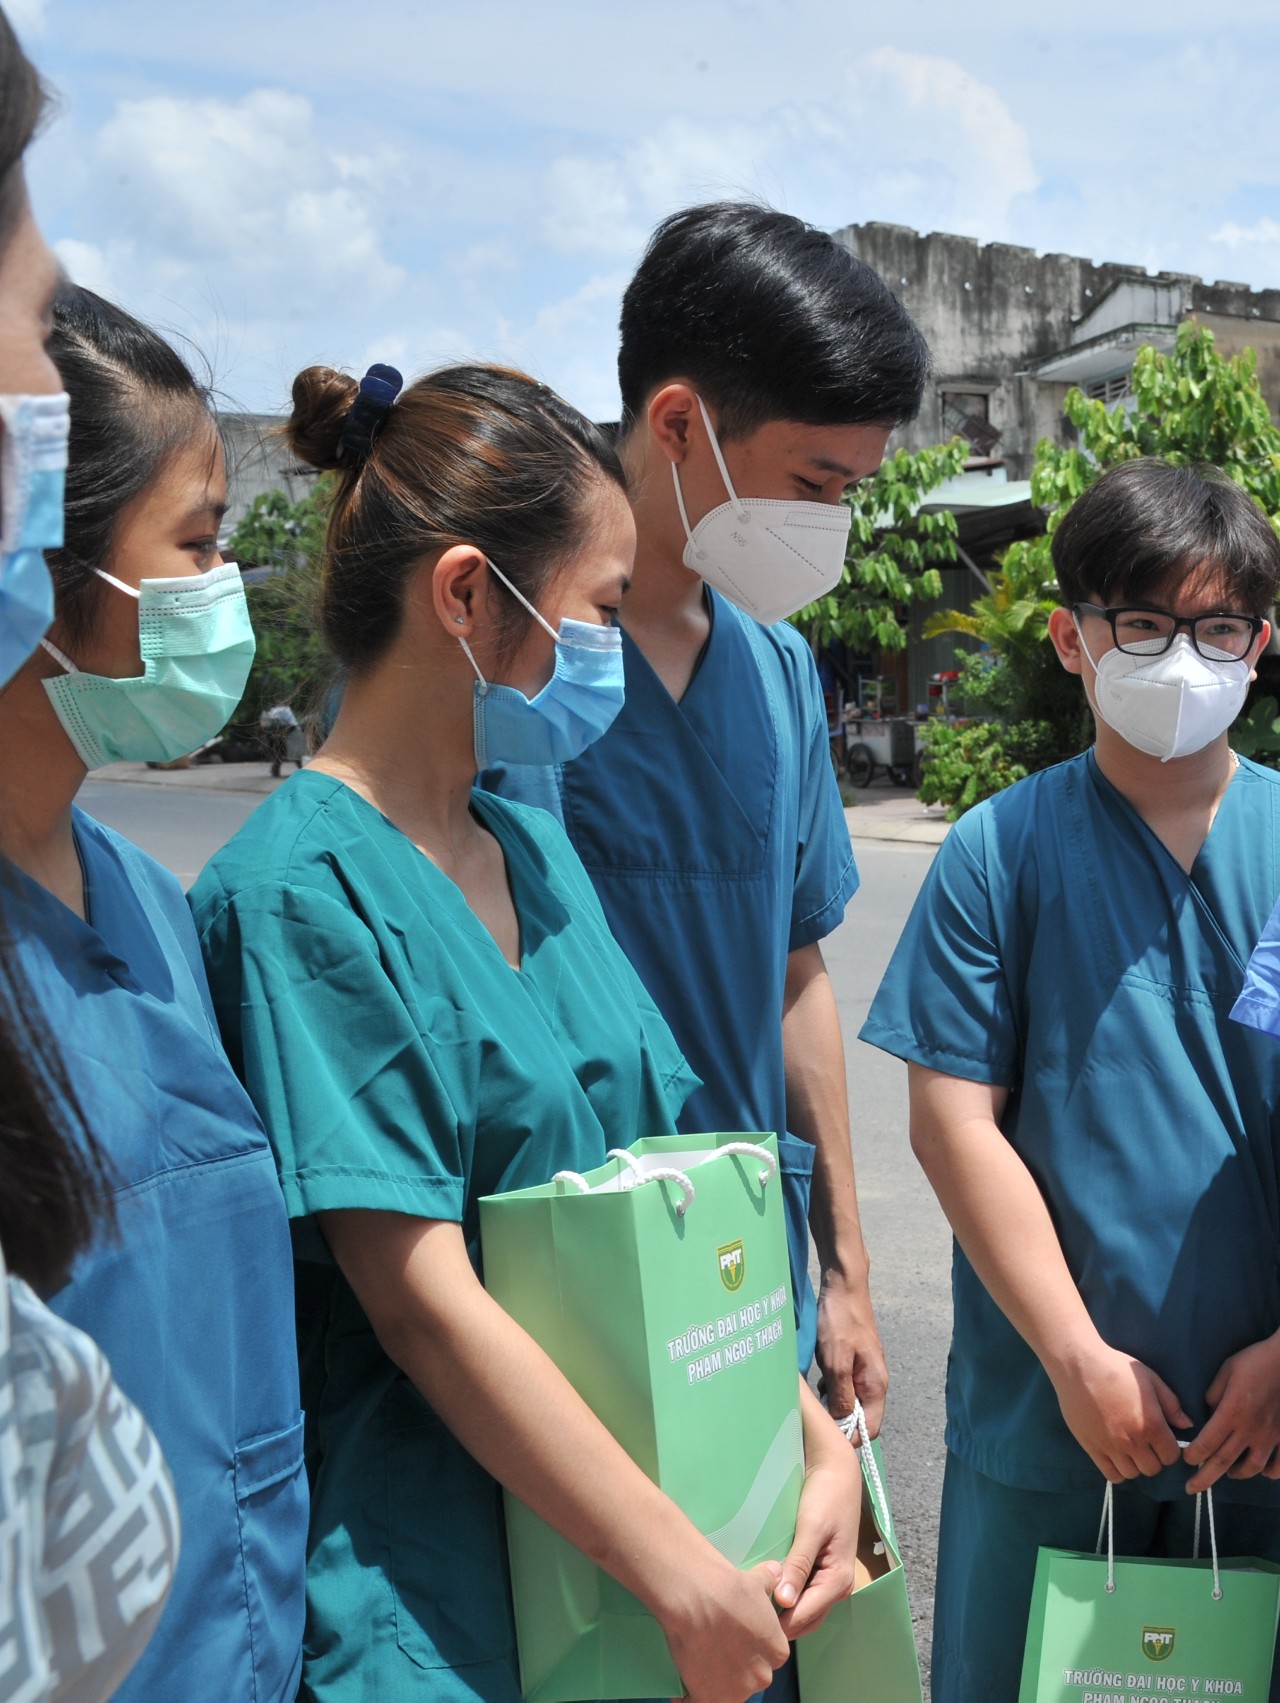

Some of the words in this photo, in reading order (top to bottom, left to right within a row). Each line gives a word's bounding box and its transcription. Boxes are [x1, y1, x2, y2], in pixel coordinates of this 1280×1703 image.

[667, 1323, 715, 1362] TRƯỜNG
[717, 1312, 737, 1340] ĐẠI
[739, 1301, 761, 1329] HỌC
[762, 1296, 770, 1317] Y
[770, 1285, 787, 1314] KHOA
[687, 1350, 721, 1384] PHẠM
[724, 1335, 754, 1366] NGỌC
[755, 1318, 783, 1350] THẠCH
[1063, 1668, 1122, 1688] TRƯỜNG
[1127, 1674, 1151, 1691] ĐẠI
[1156, 1676, 1186, 1694] HỌC
[1191, 1678, 1200, 1692] Y
[1204, 1679, 1243, 1695] KHOA
